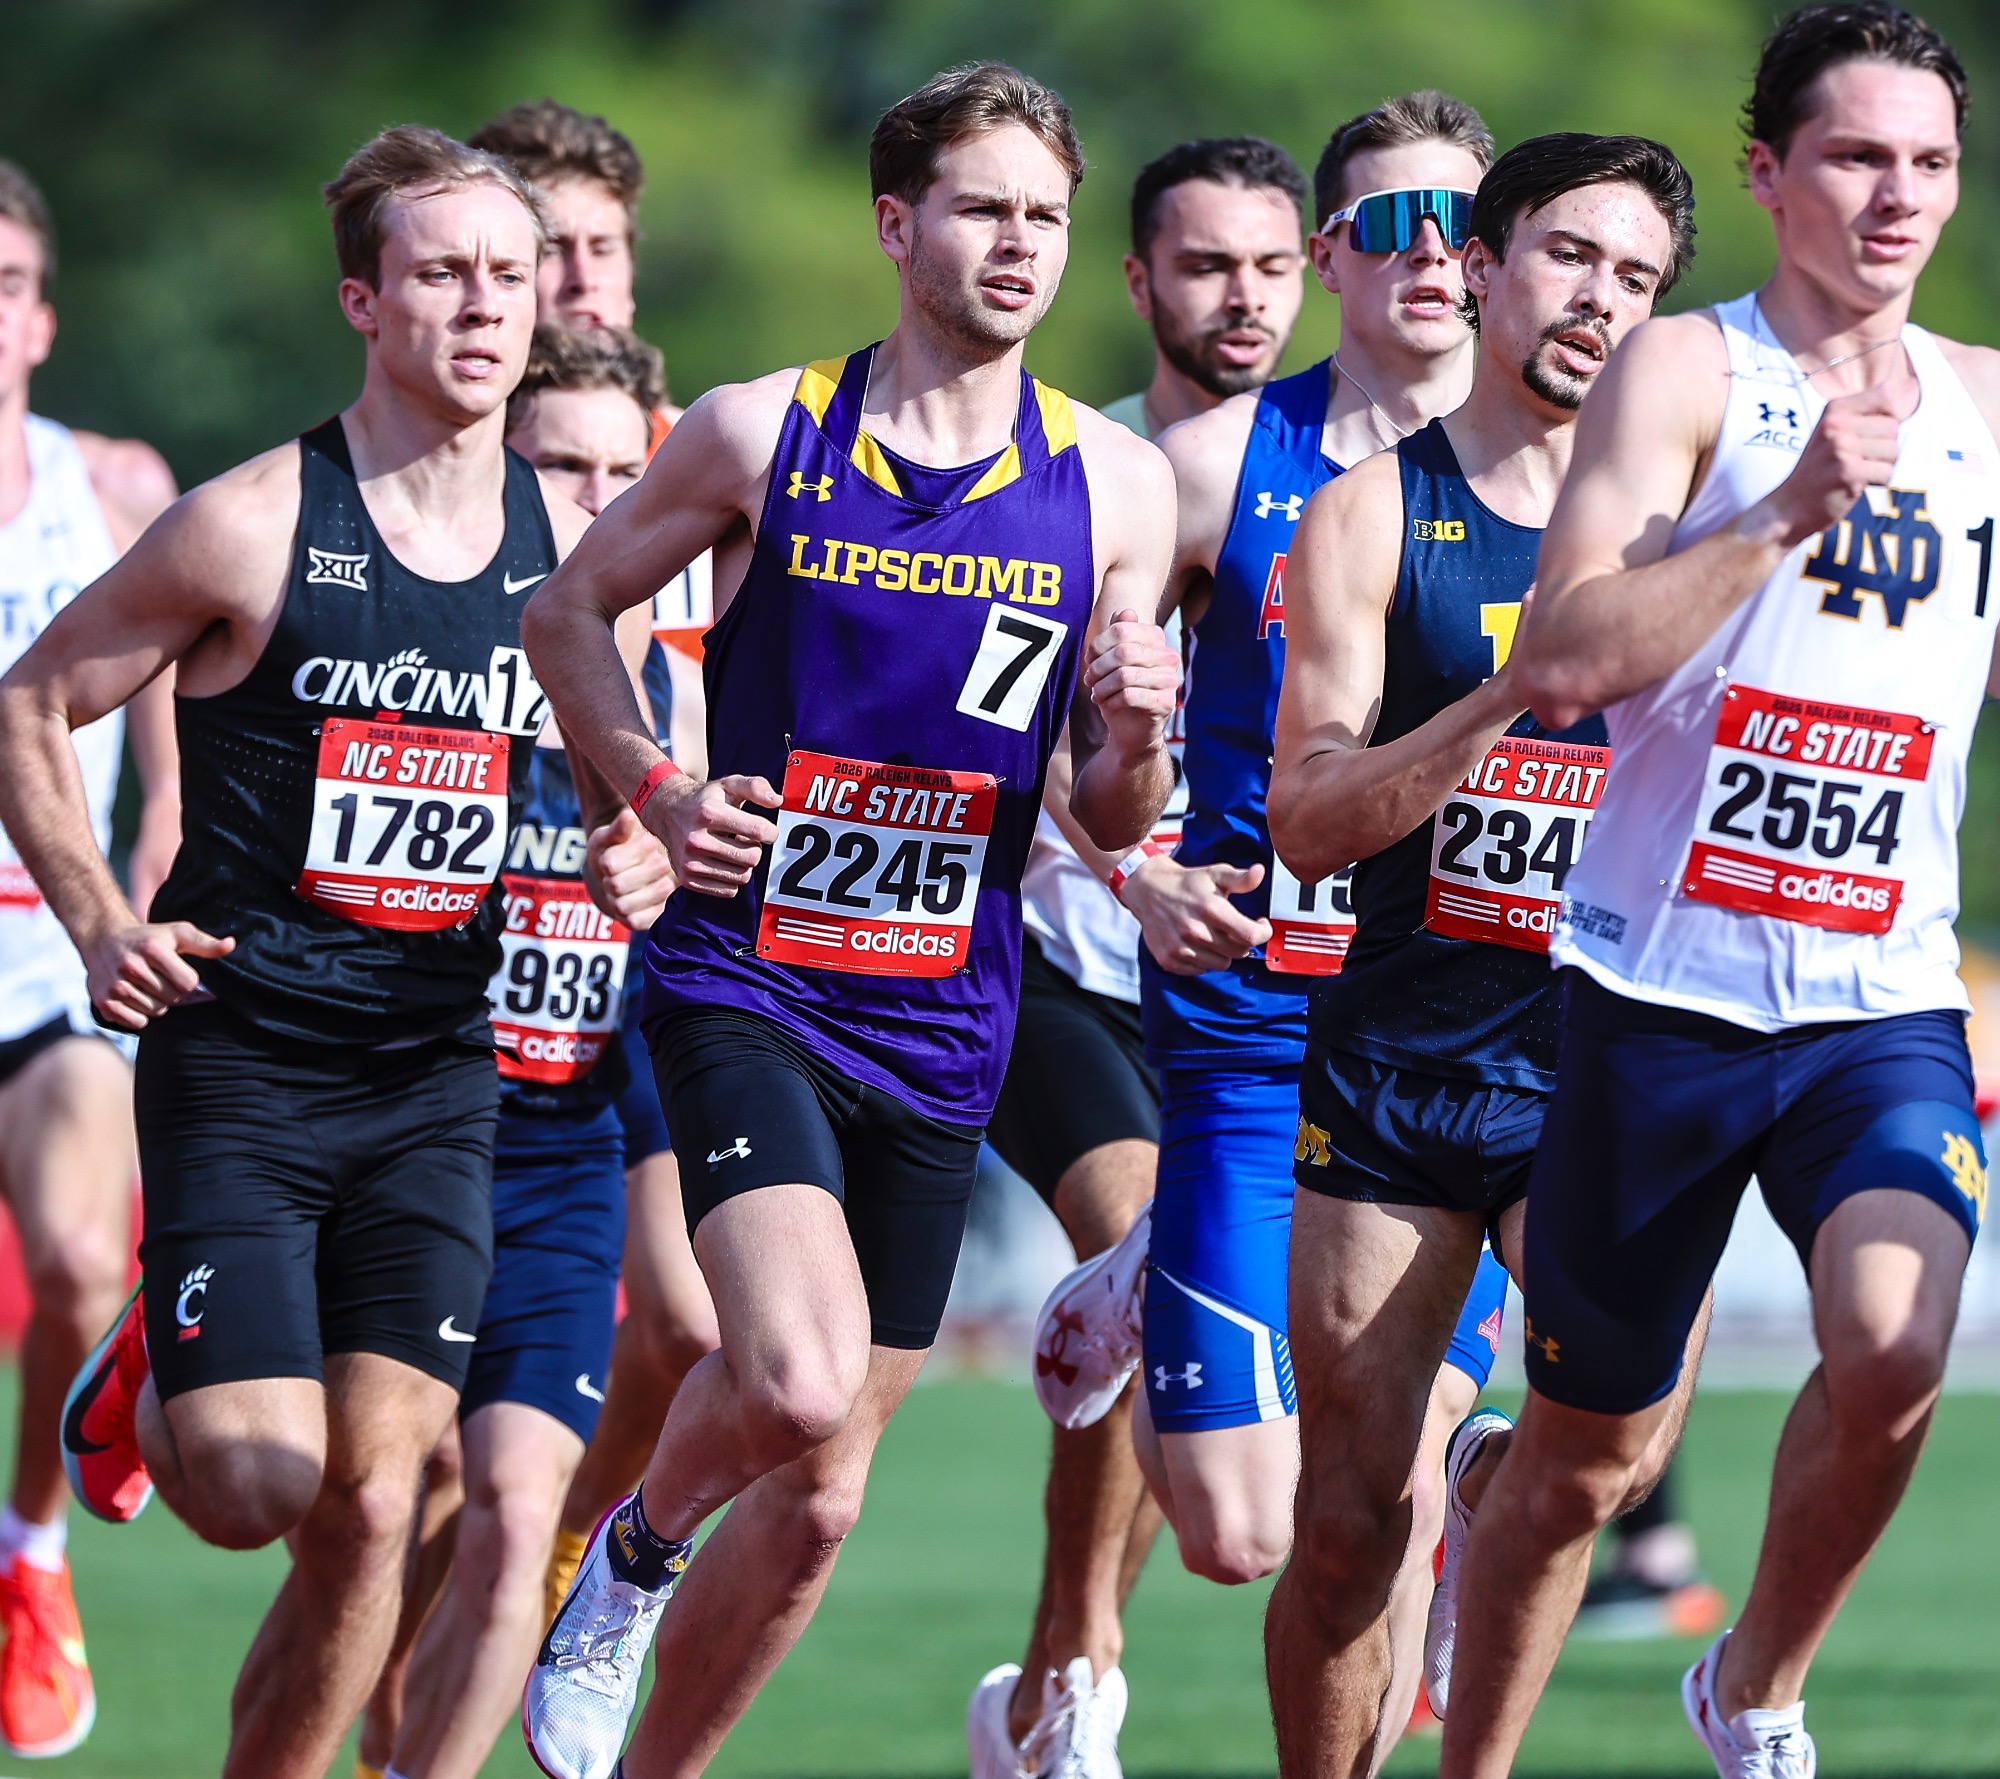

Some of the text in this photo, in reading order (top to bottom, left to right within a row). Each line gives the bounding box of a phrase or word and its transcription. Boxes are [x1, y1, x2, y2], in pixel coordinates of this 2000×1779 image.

[1744, 429, 1801, 450] ACC
[787, 533, 1063, 606] LIPSCOMB
[1966, 516, 1994, 618] 1
[978, 614, 1054, 714] 7
[340, 740, 494, 790] NC STATE
[1514, 743, 1561, 759] RALEIGH
[1563, 748, 1605, 764] RELAYS
[1738, 709, 1914, 774] NC STATE
[804, 774, 974, 829] NC STATE
[833, 762, 953, 787] 2026 RALEIGH RELAYS
[1513, 758, 1609, 803] STAT
[330, 792, 495, 875] 1782
[1708, 761, 1905, 865] 2554
[778, 823, 974, 915] 2245
[1438, 801, 1593, 891] 234
[381, 883, 478, 912] adidas
[535, 900, 615, 940] STATE
[1778, 873, 1891, 913] adidas
[850, 927, 957, 957] adidas
[489, 948, 614, 1020] 933
